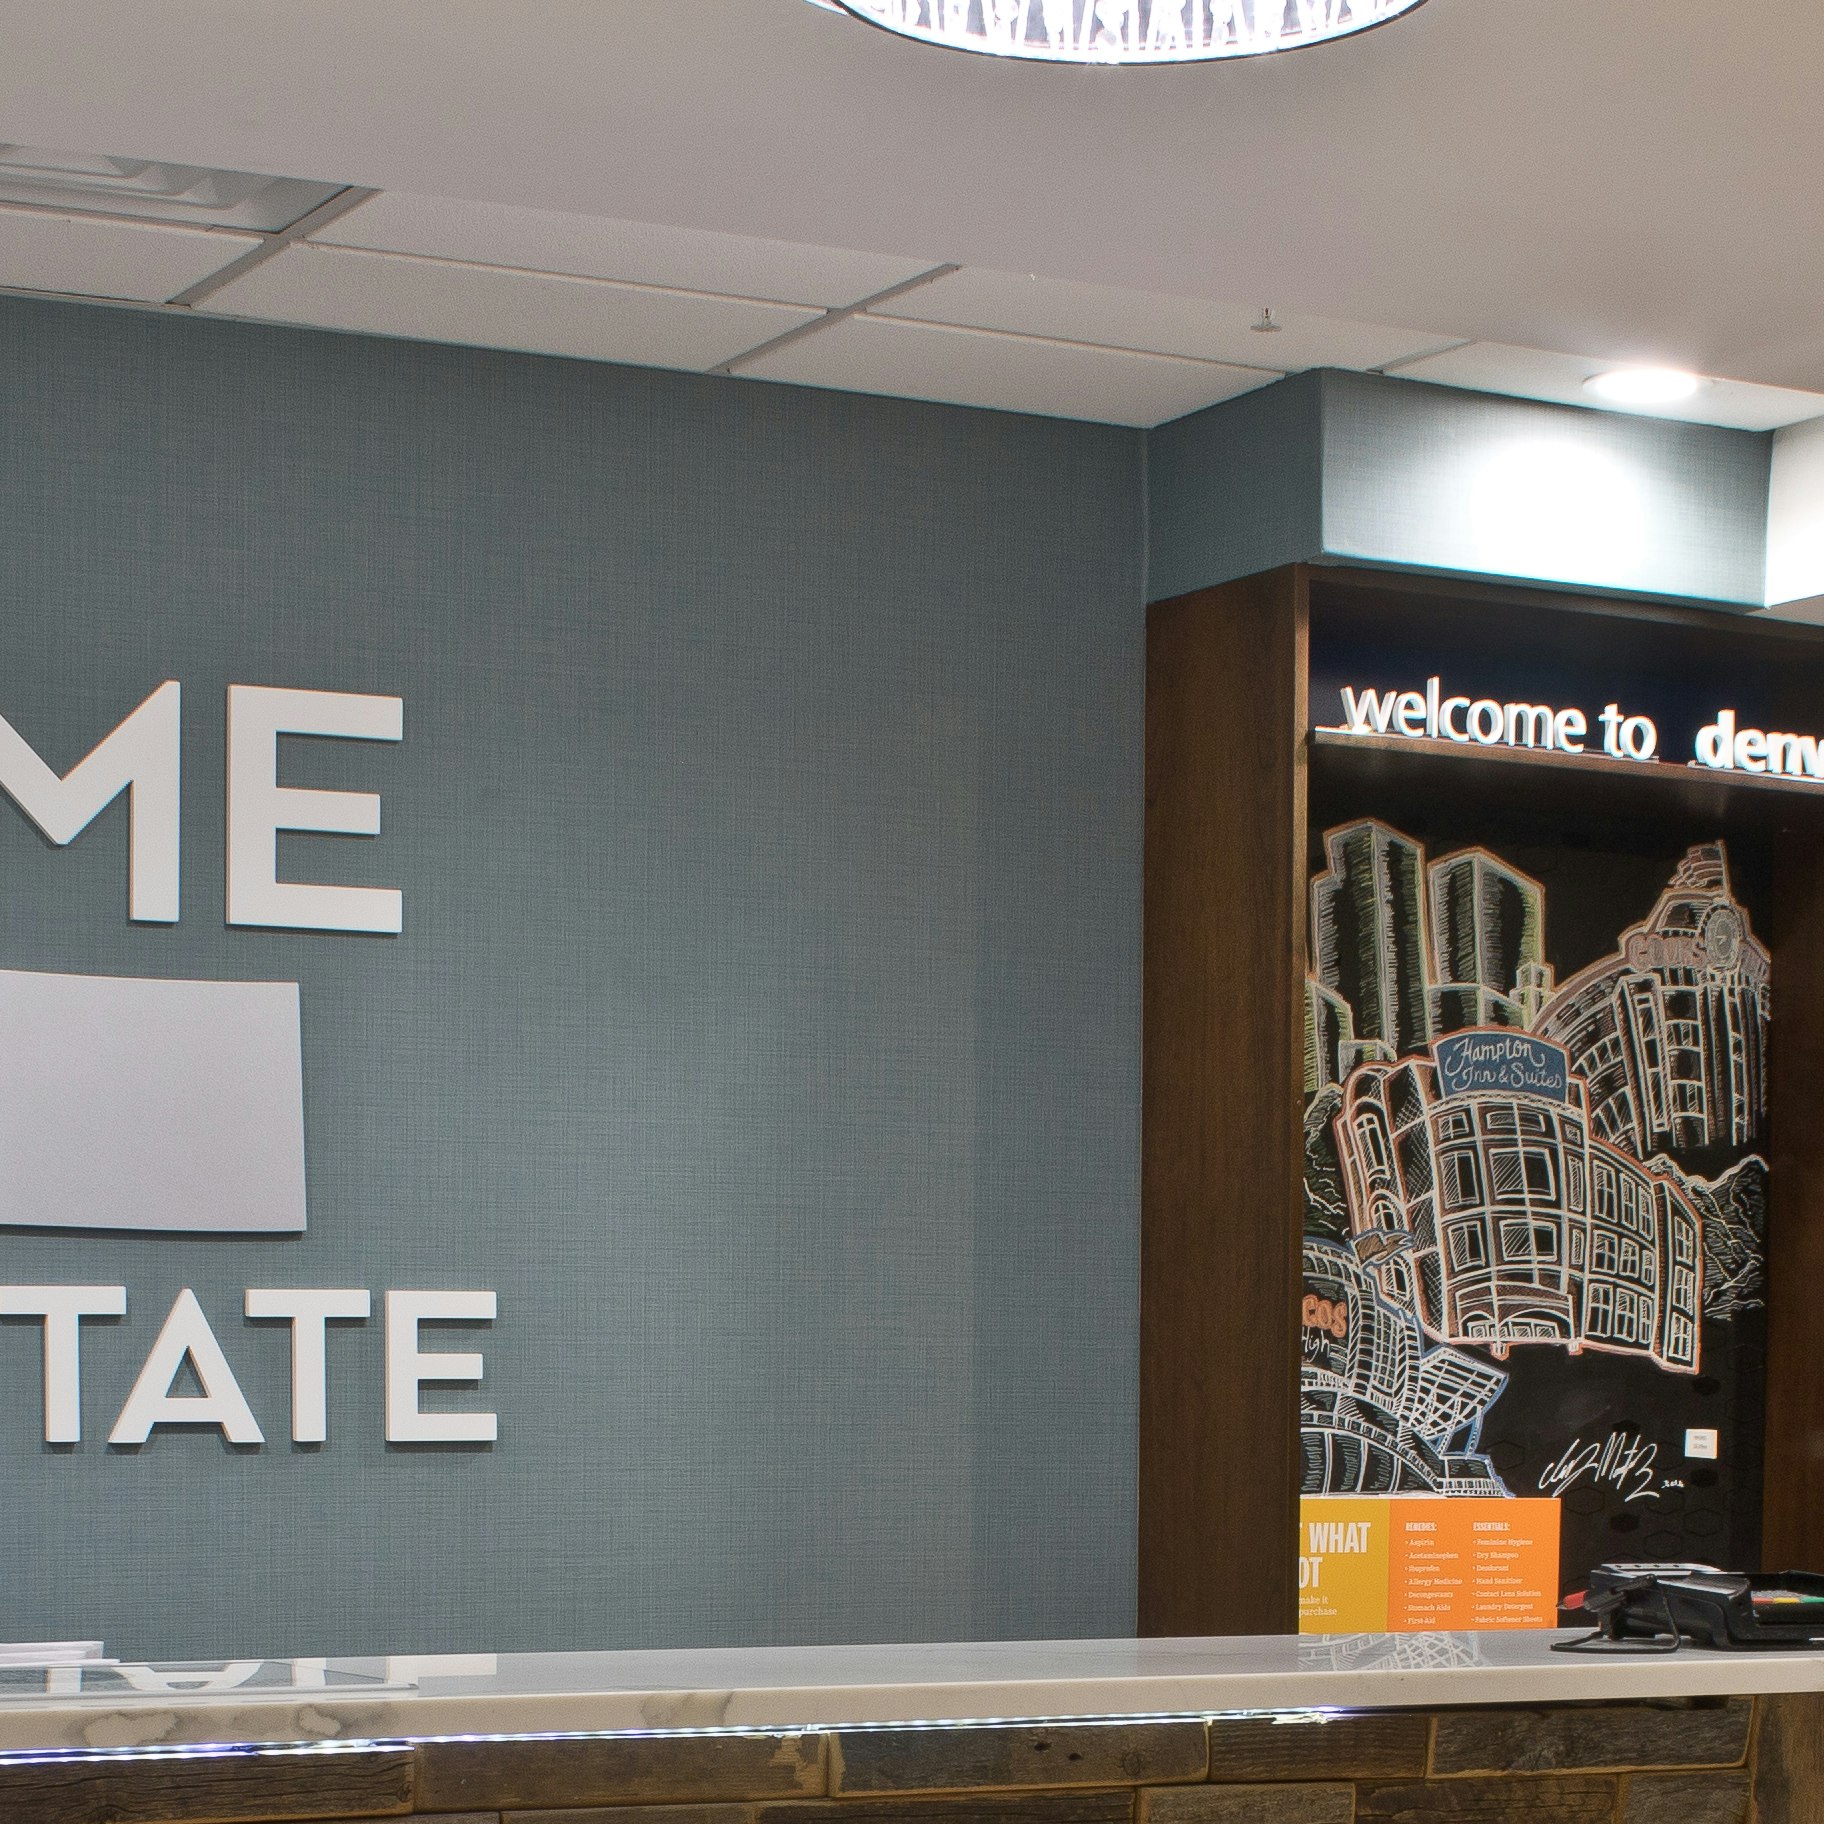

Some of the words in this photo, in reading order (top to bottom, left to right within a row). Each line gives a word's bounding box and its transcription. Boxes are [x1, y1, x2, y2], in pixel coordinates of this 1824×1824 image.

[1340, 676, 1587, 752] welcome
[1599, 703, 1659, 761] to
[1445, 1037, 1546, 1076] Hampton
[1451, 1065, 1496, 1091] Inn
[1498, 1064, 1509, 1084] &
[1511, 1062, 1562, 1088] Suites
[1308, 1522, 1372, 1553] WHAT
